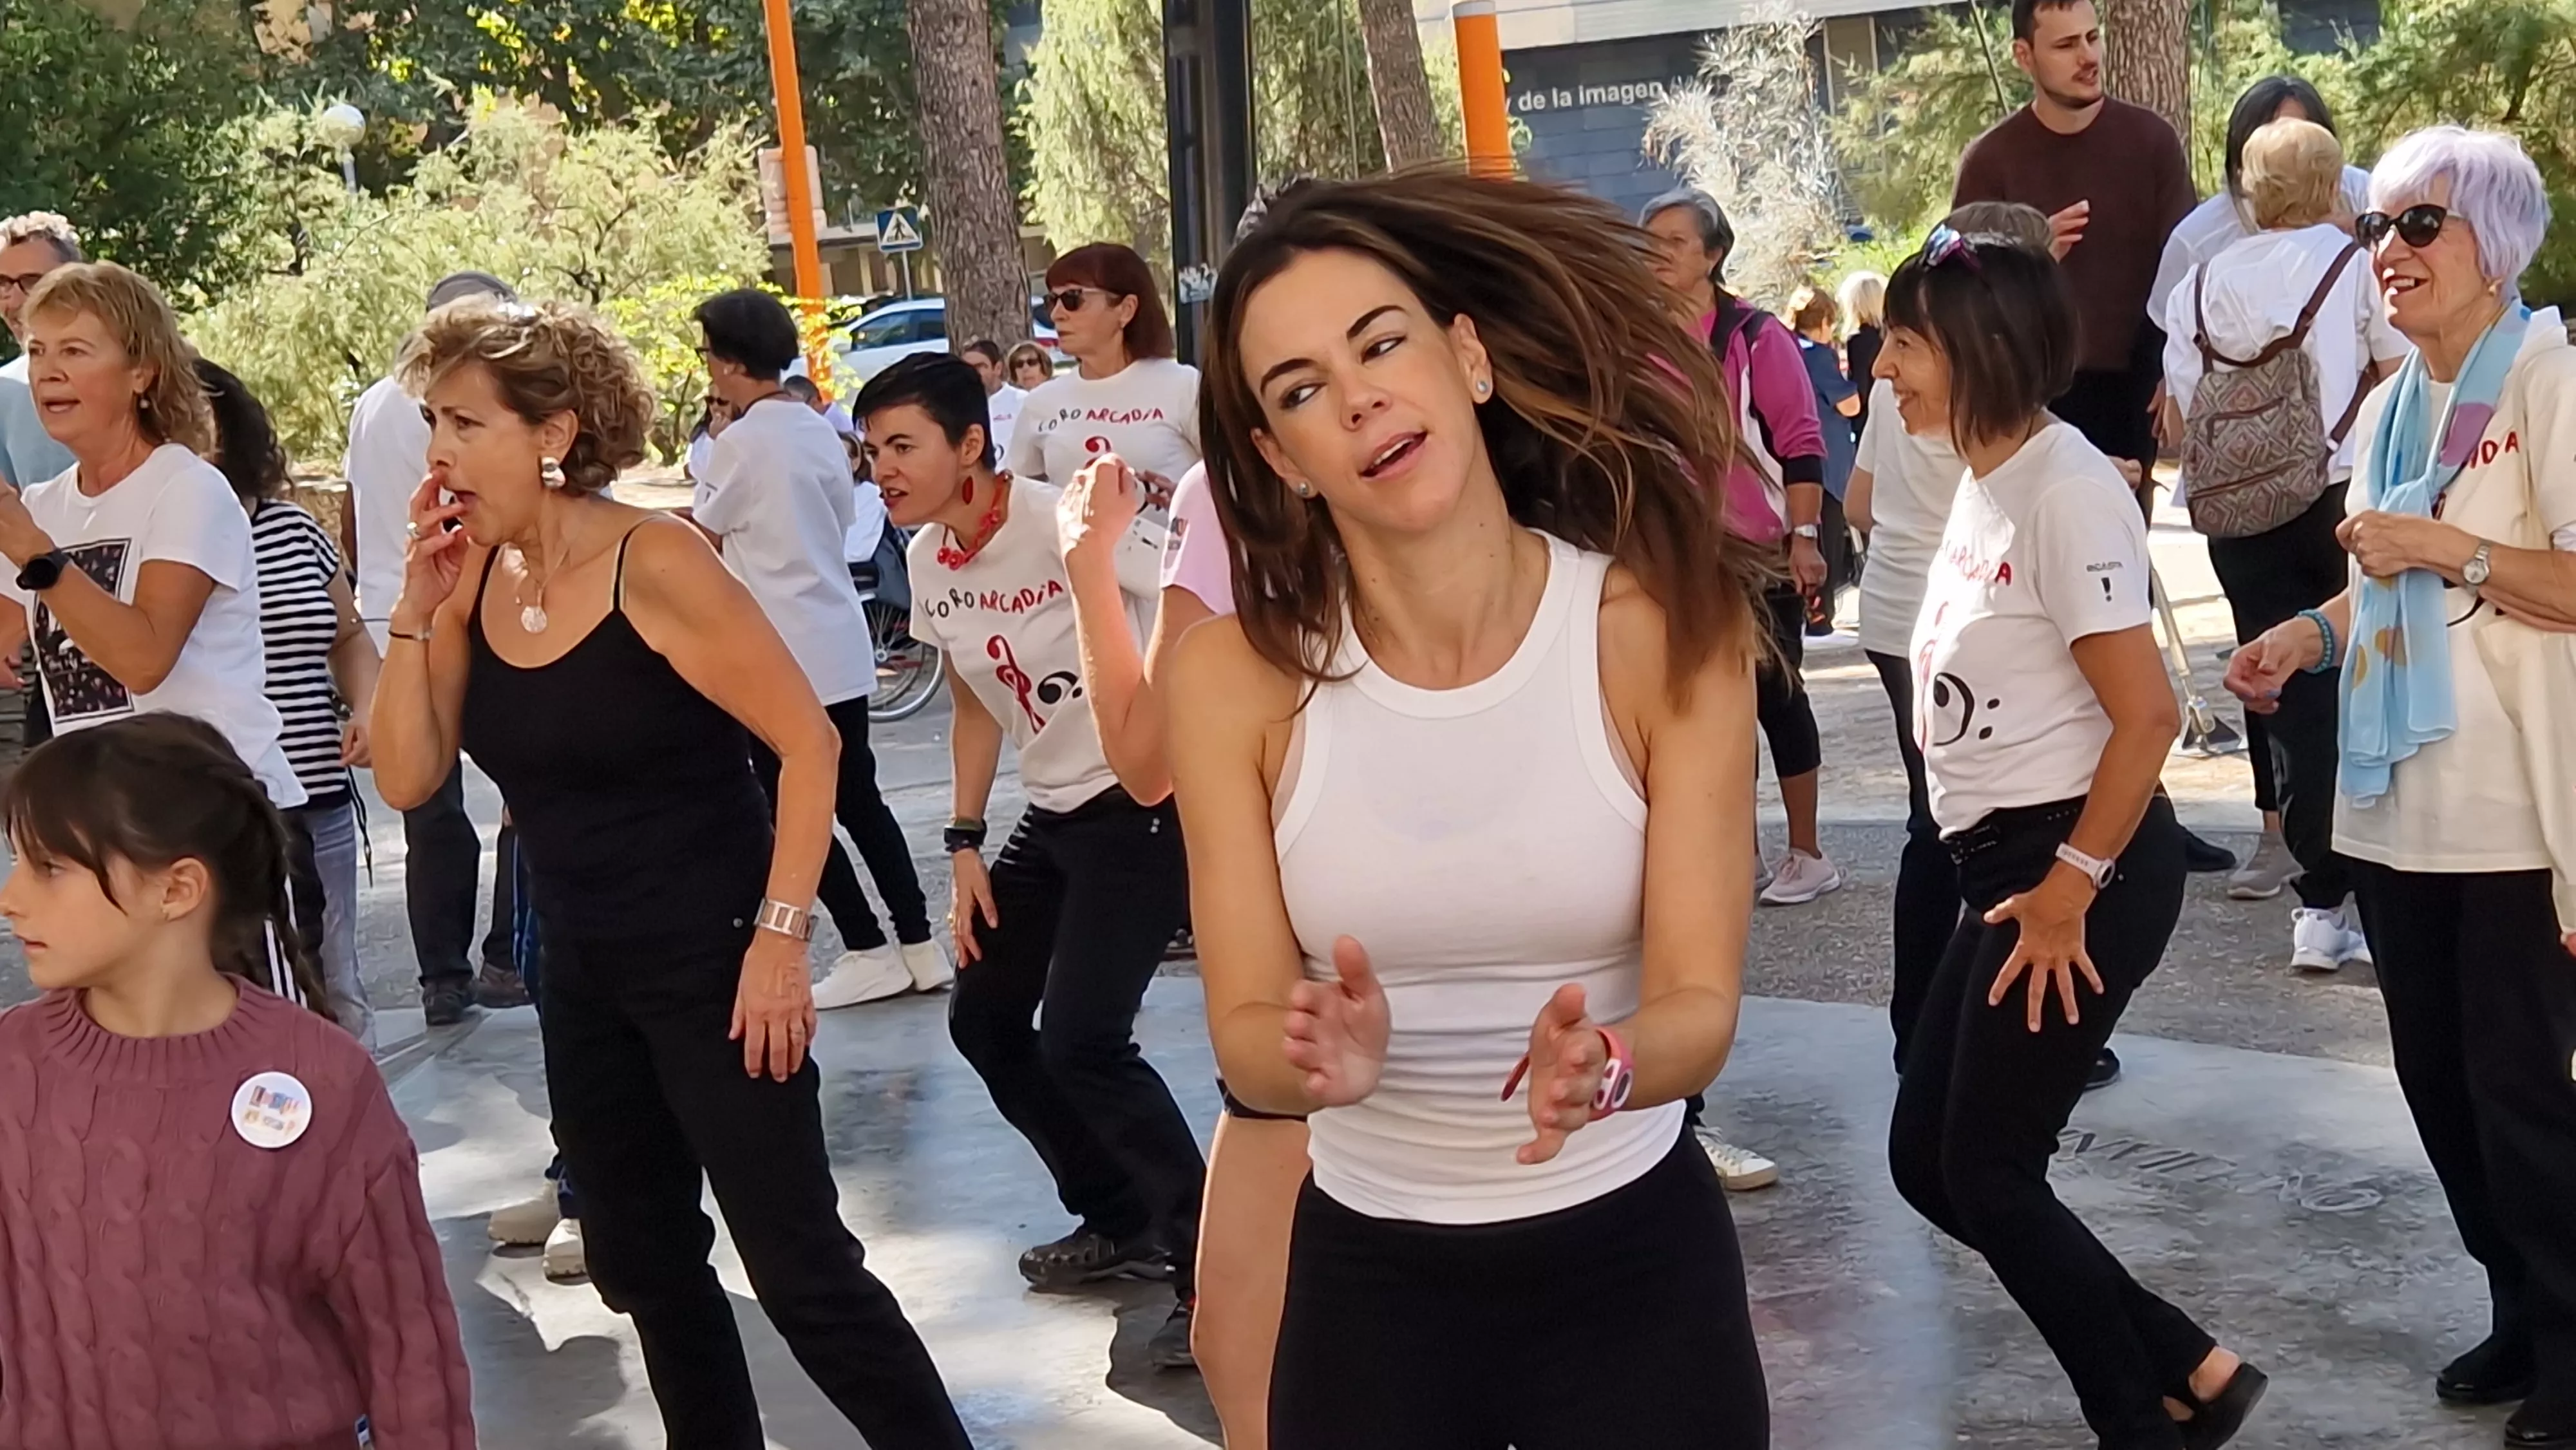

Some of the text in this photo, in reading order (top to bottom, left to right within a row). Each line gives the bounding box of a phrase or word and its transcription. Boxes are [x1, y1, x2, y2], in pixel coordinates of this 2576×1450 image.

[1518, 90, 1546, 111] de
[1551, 86, 1573, 109] la
[1578, 80, 1664, 105] imagen
[924, 587, 976, 618] CORO
